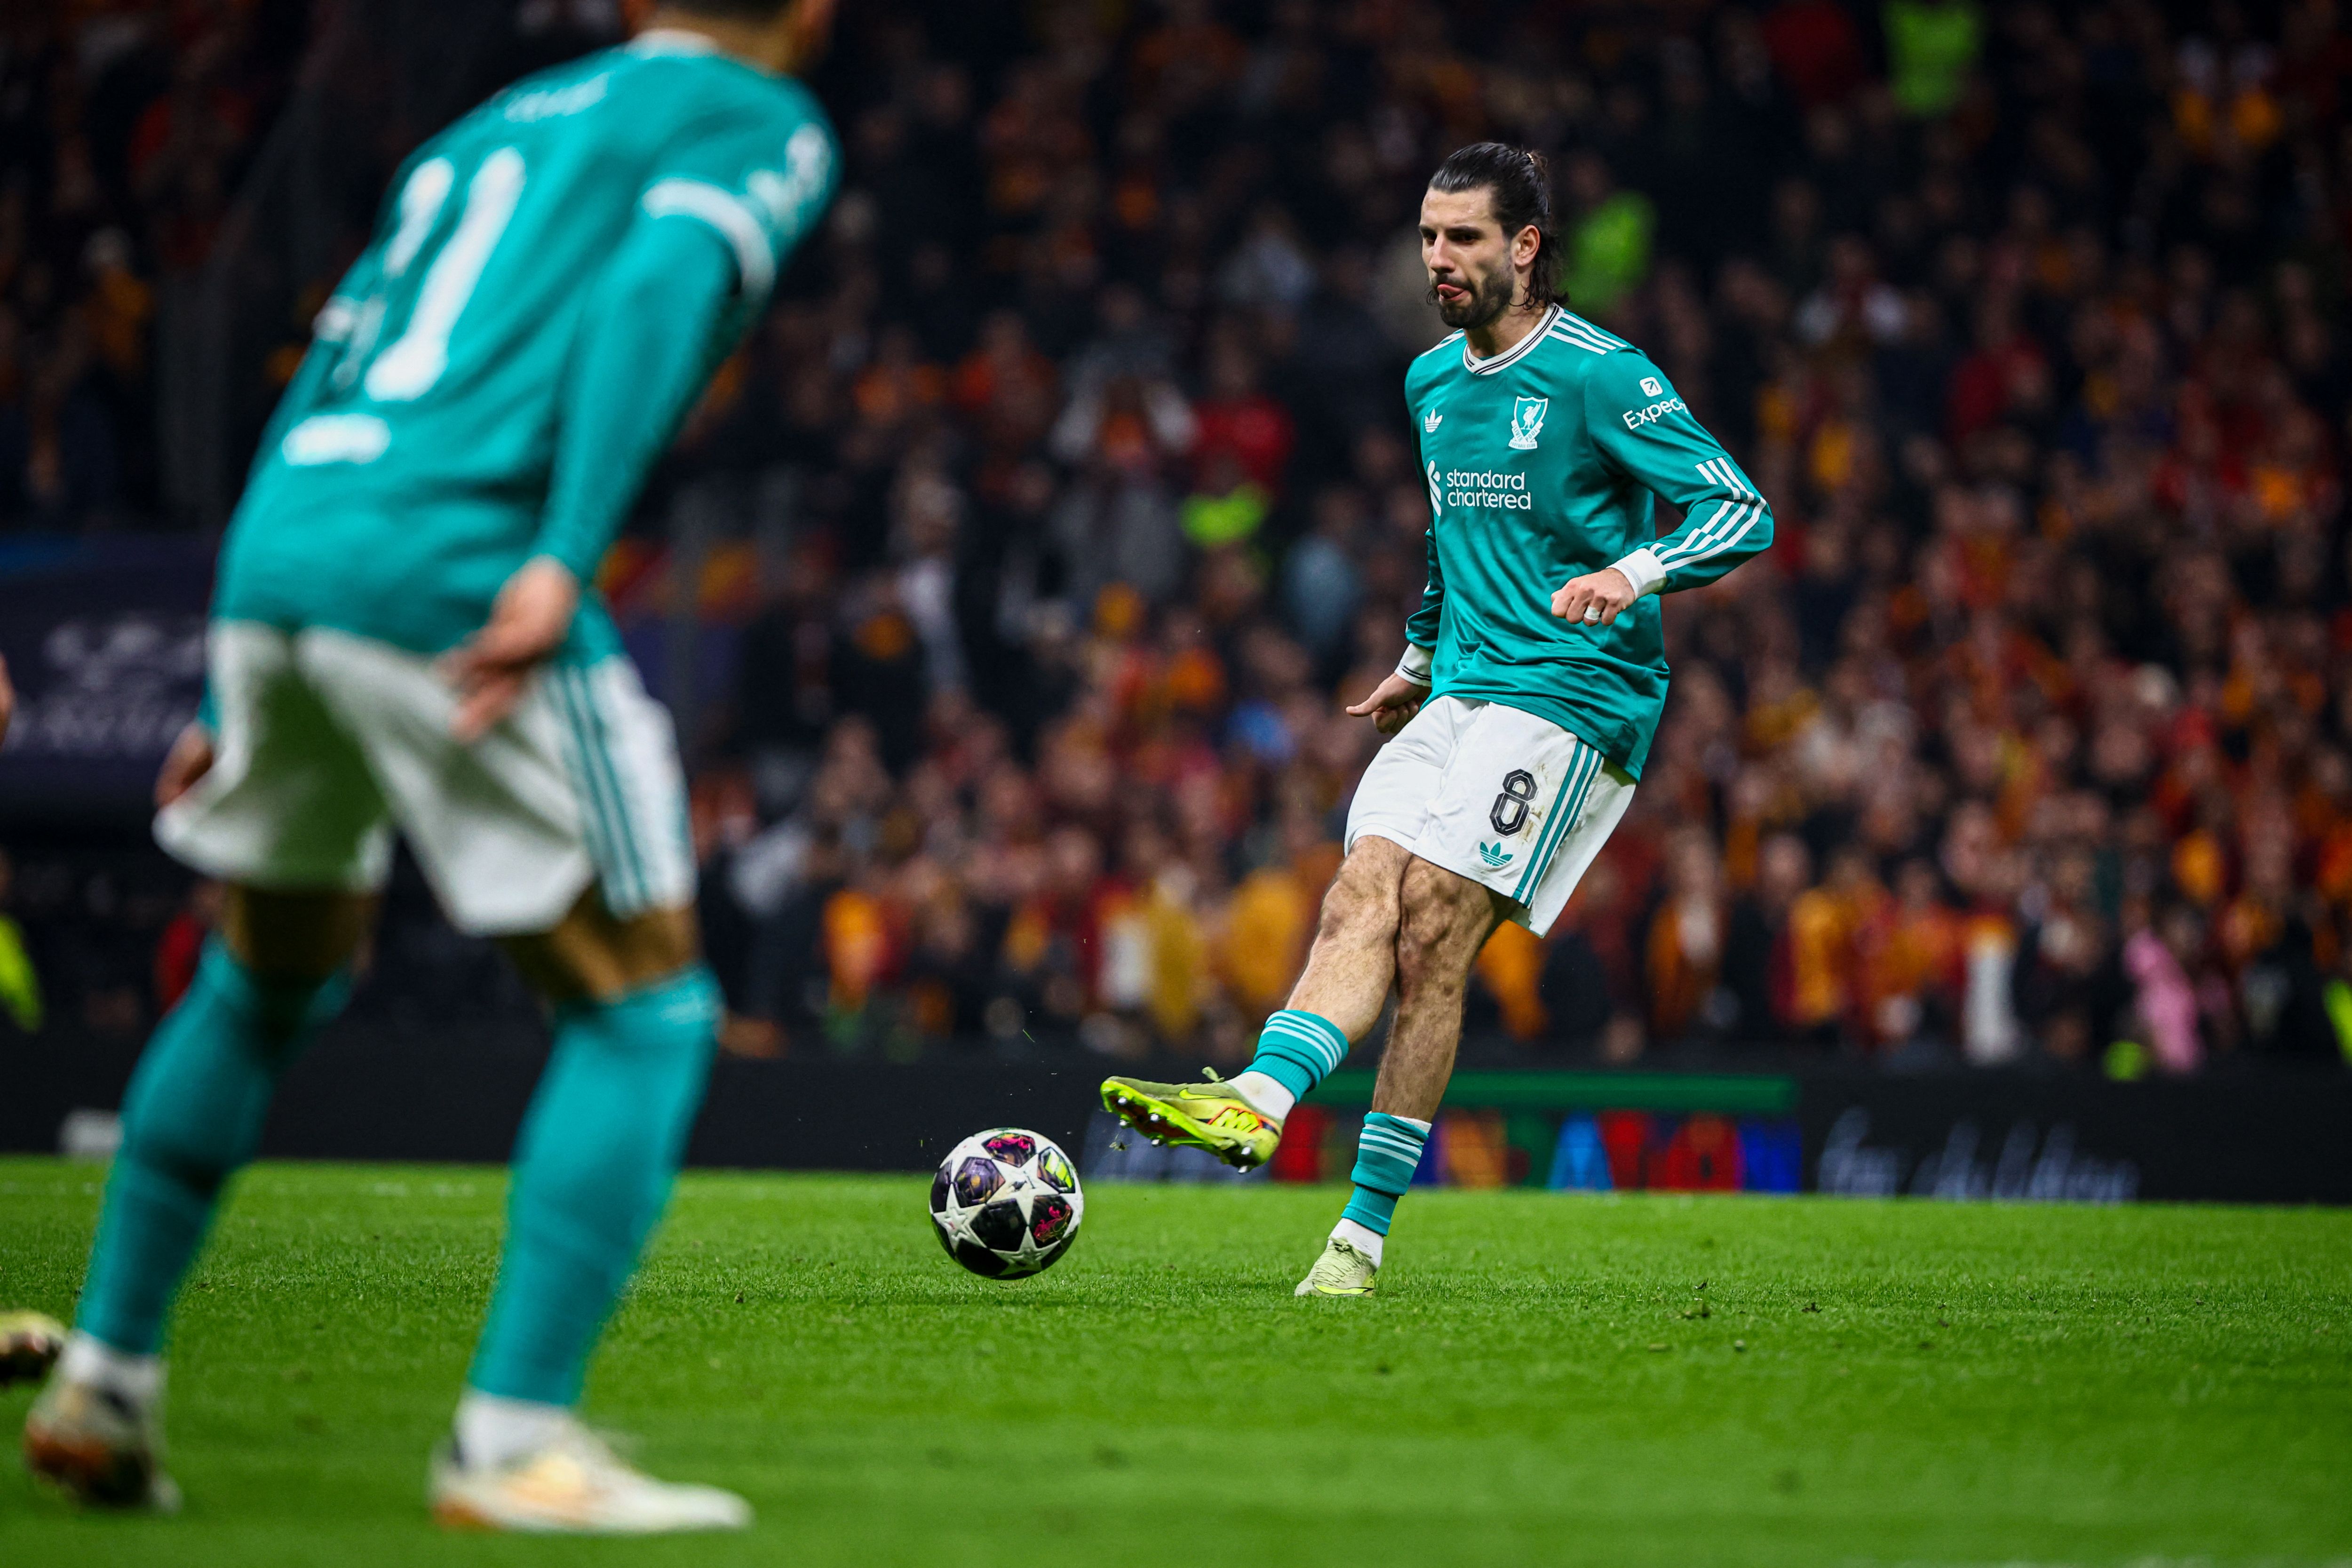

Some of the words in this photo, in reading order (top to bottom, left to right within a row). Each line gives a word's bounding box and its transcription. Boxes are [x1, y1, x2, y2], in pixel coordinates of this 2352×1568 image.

[1446, 469, 1525, 490] standard
[1447, 488, 1531, 510] chartered
[1489, 768, 1539, 839] 8
